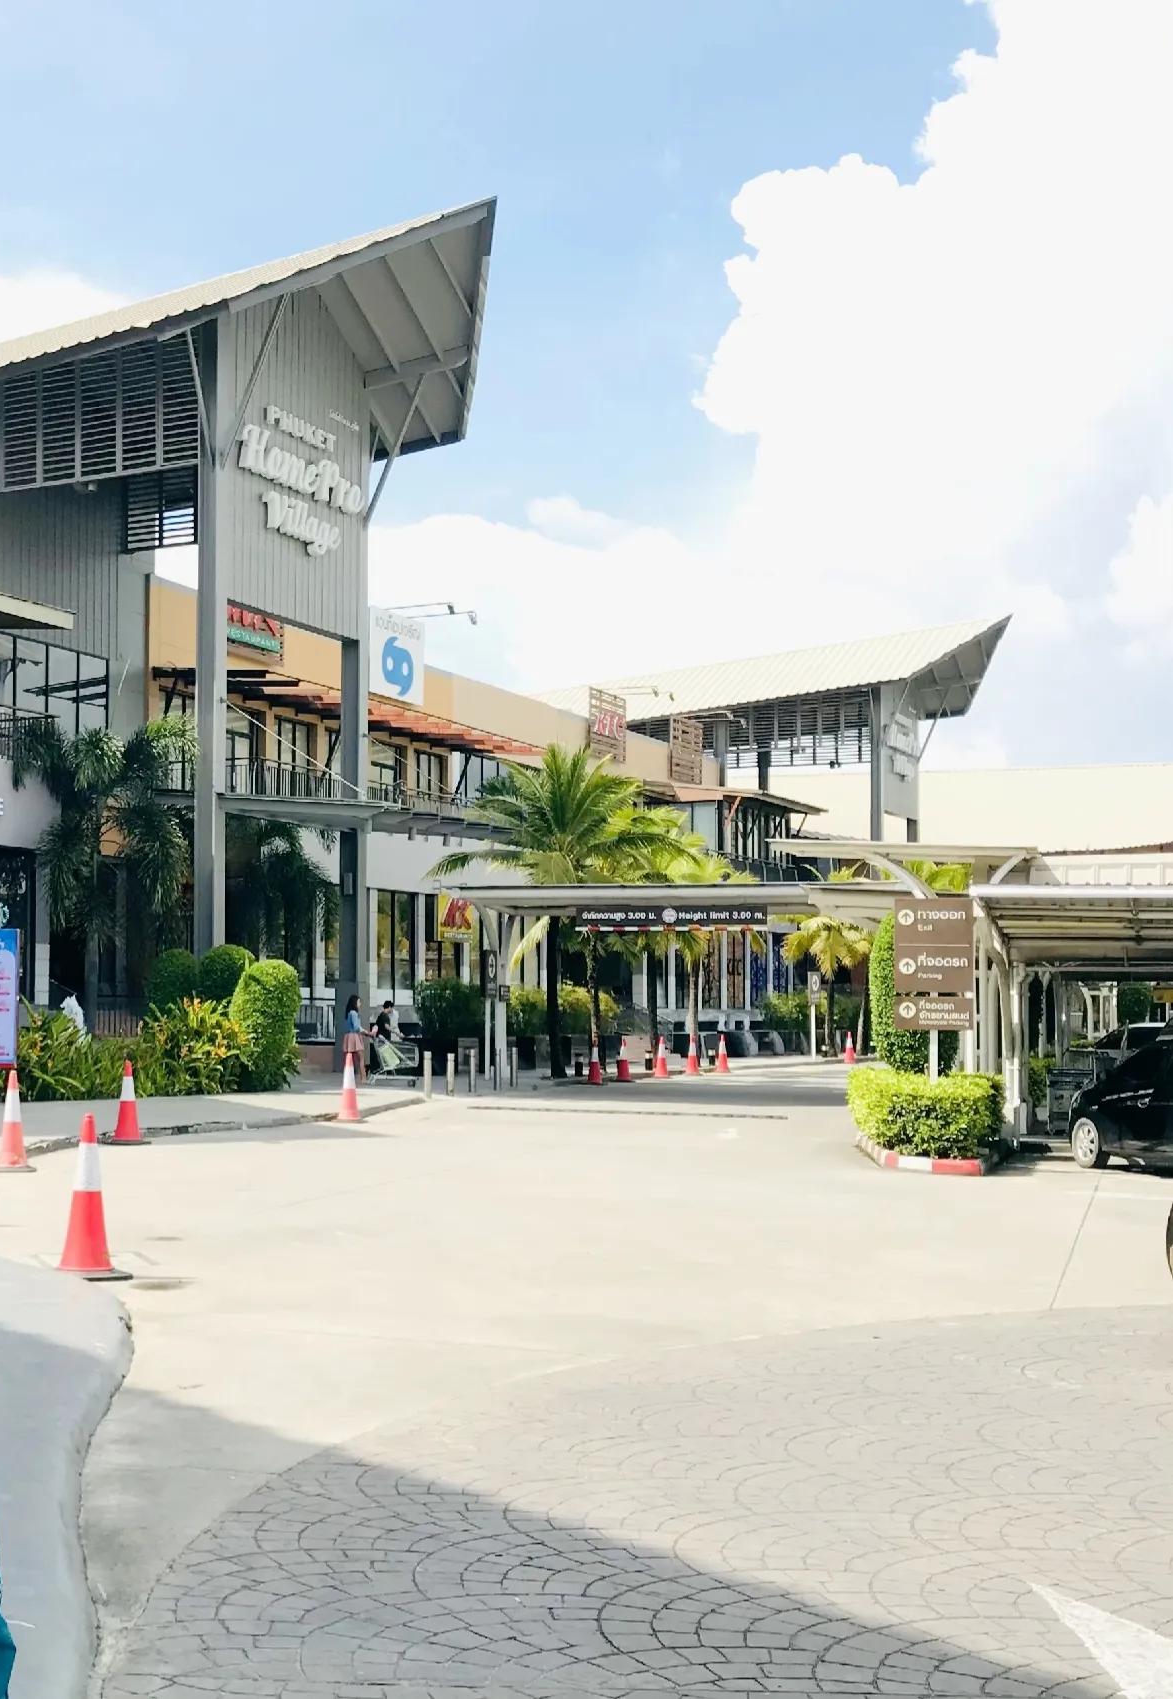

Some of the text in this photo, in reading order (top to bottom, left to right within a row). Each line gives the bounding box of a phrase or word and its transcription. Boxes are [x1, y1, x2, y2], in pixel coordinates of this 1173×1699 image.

[264, 404, 337, 452] PHUKET
[261, 490, 342, 557] Village
[594, 711, 625, 740] KFC
[678, 911, 708, 921] Height
[710, 911, 730, 920] limit
[732, 911, 752, 920] 3.00
[917, 909, 966, 920] ทางออก
[917, 923, 933, 932] Exit
[917, 952, 969, 968] ที่จอดรถ
